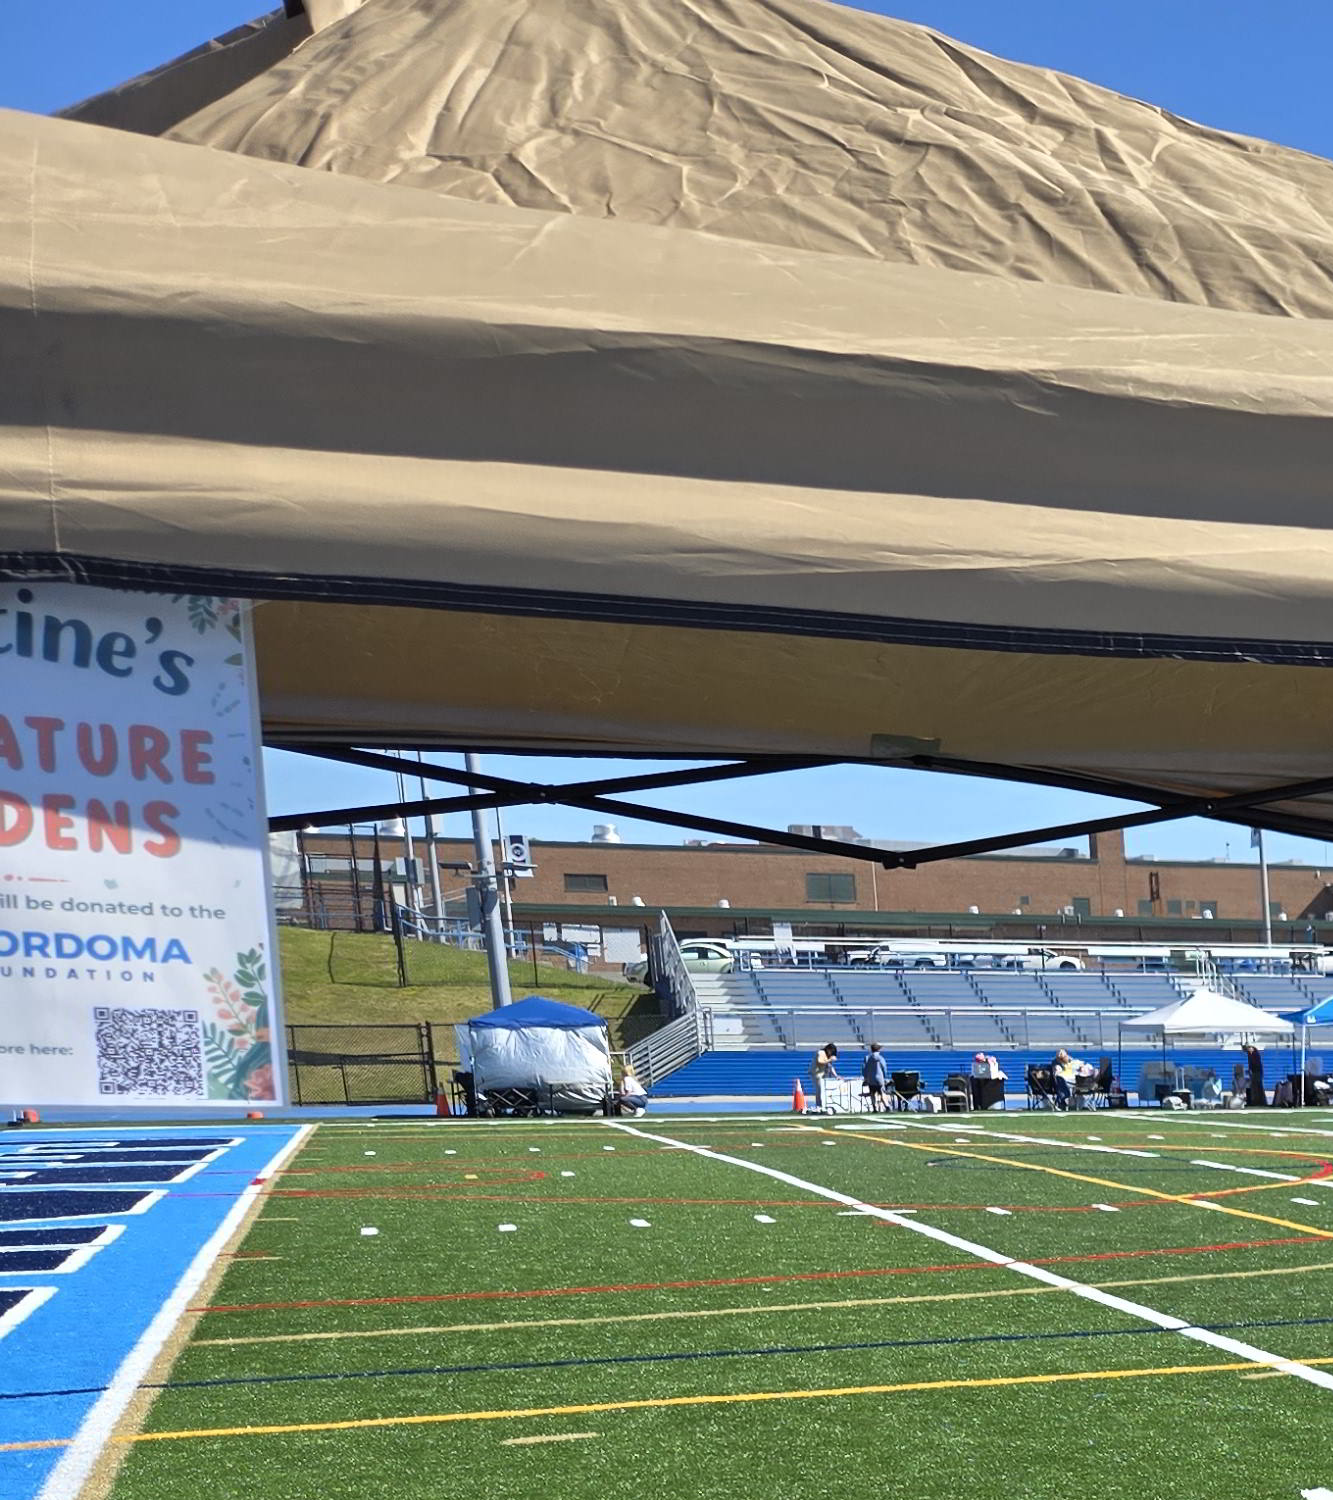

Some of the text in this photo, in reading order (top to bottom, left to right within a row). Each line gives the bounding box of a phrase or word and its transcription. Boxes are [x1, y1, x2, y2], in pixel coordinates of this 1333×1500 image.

[25, 895, 54, 914] be
[61, 897, 155, 919] donated
[161, 901, 184, 919] to
[193, 903, 226, 921] the
[30, 1043, 74, 1057] here:
